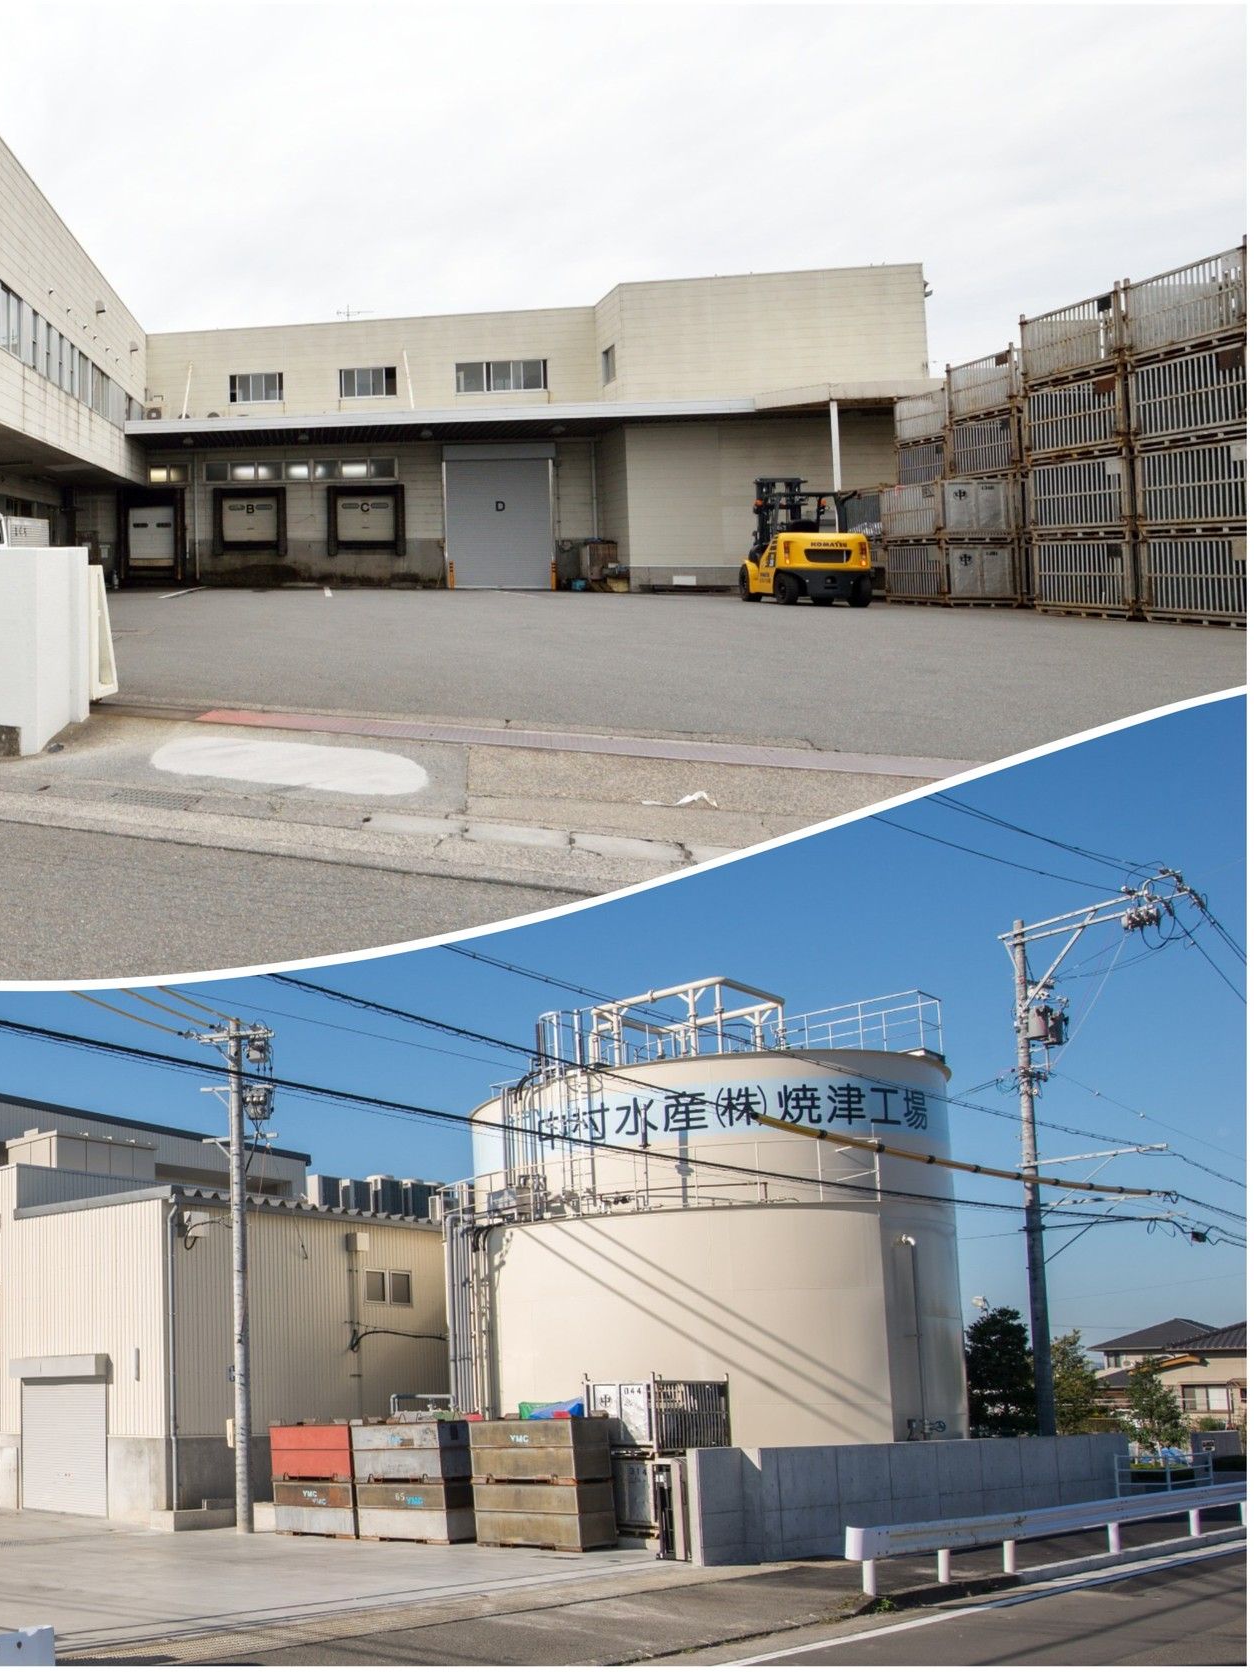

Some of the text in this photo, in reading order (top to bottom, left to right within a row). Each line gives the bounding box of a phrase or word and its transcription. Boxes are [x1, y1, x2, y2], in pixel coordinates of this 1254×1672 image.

[246, 504, 255, 514] B
[360, 502, 371, 513] C
[495, 501, 506, 512] D
[510, 1434, 529, 1443] YMC
[302, 1490, 318, 1498] YMC
[312, 1498, 327, 1506] YMC
